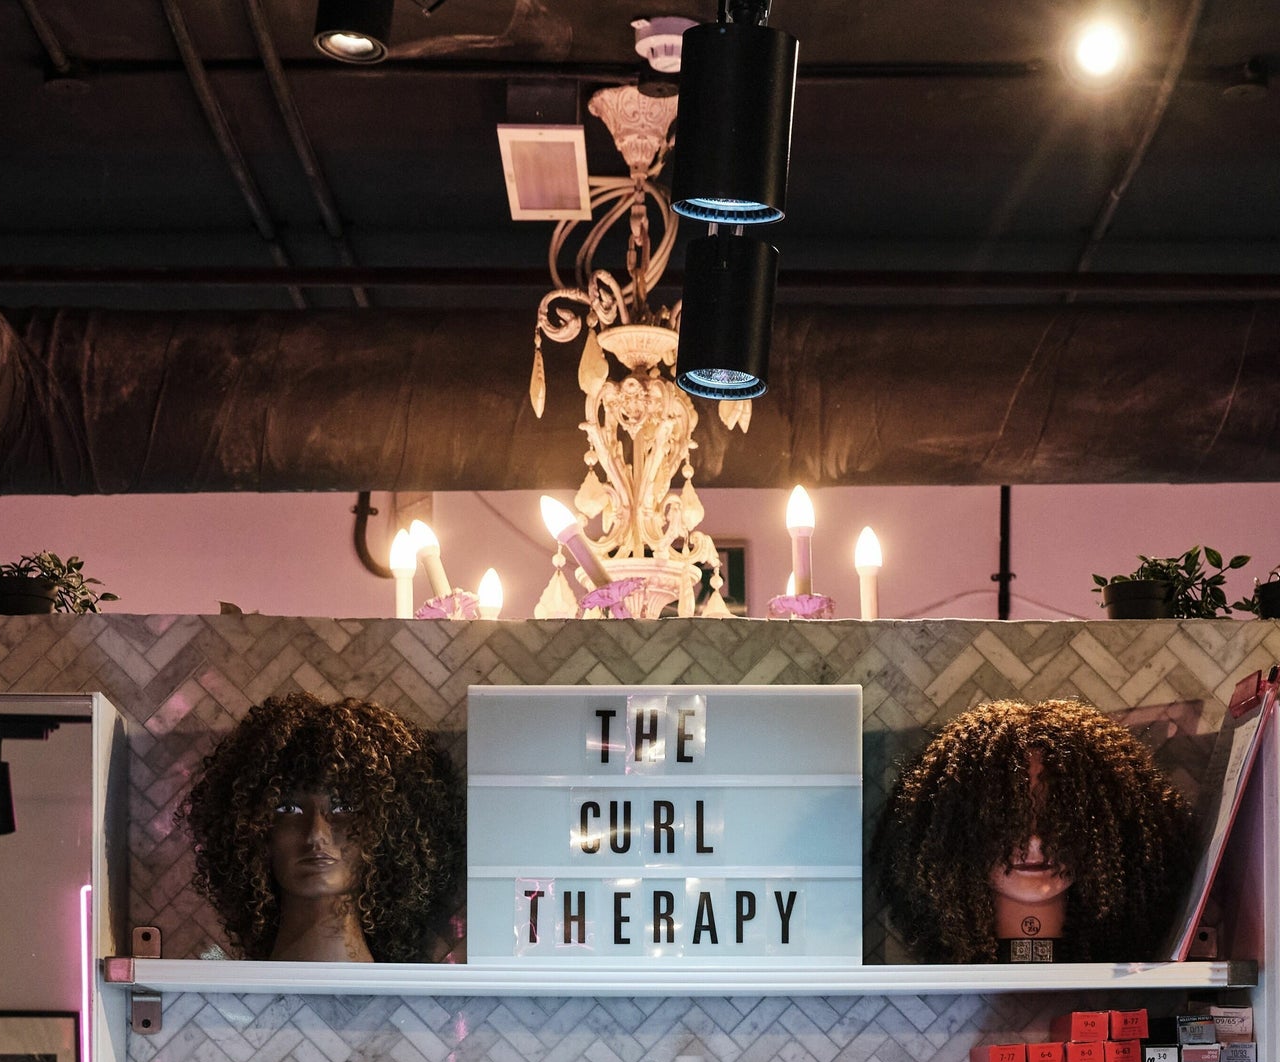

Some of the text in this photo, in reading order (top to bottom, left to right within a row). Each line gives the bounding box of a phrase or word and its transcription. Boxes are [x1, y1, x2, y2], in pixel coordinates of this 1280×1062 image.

[595, 709, 696, 763] THE
[580, 800, 714, 854] CURL
[524, 891, 797, 945] THERAPY
[999, 1053, 1015, 1062] 7-77
